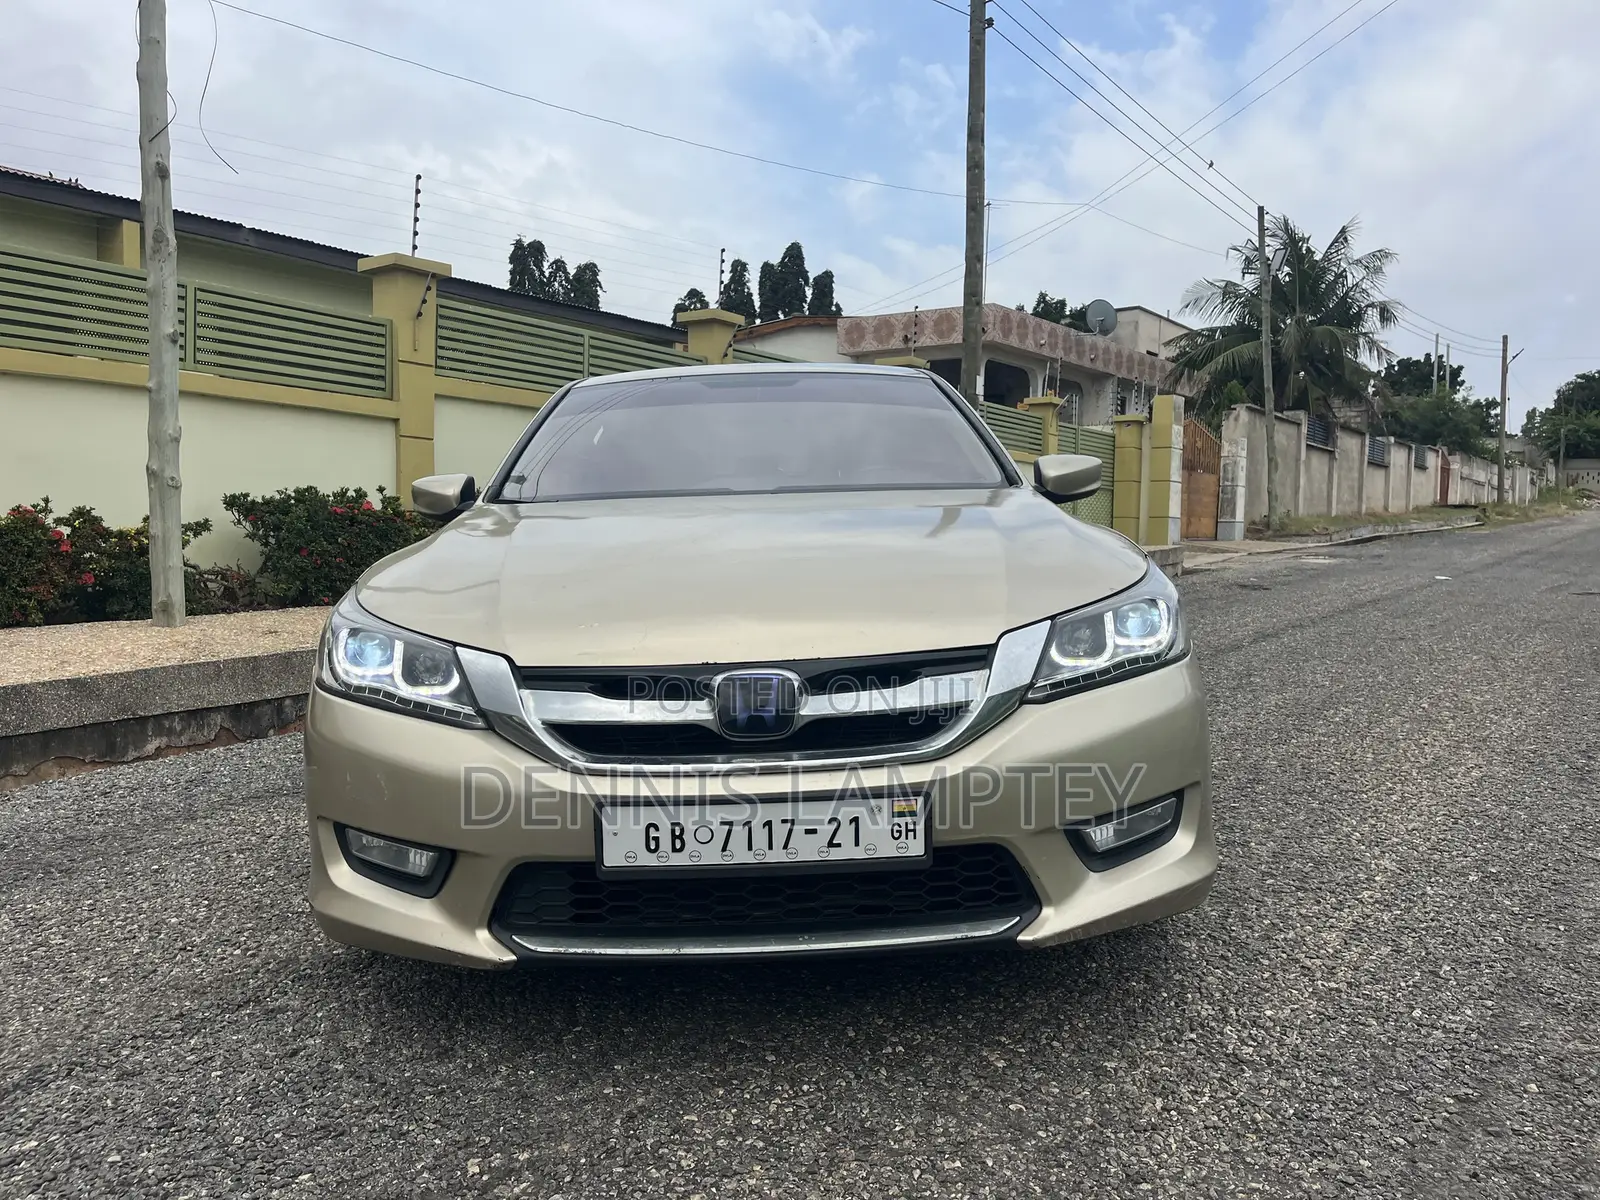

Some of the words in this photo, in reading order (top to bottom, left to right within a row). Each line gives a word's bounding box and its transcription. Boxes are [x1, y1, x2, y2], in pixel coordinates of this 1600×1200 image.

[644, 821, 686, 854] GB
[718, 815, 860, 853] 7117-21
[890, 820, 917, 841] GH
